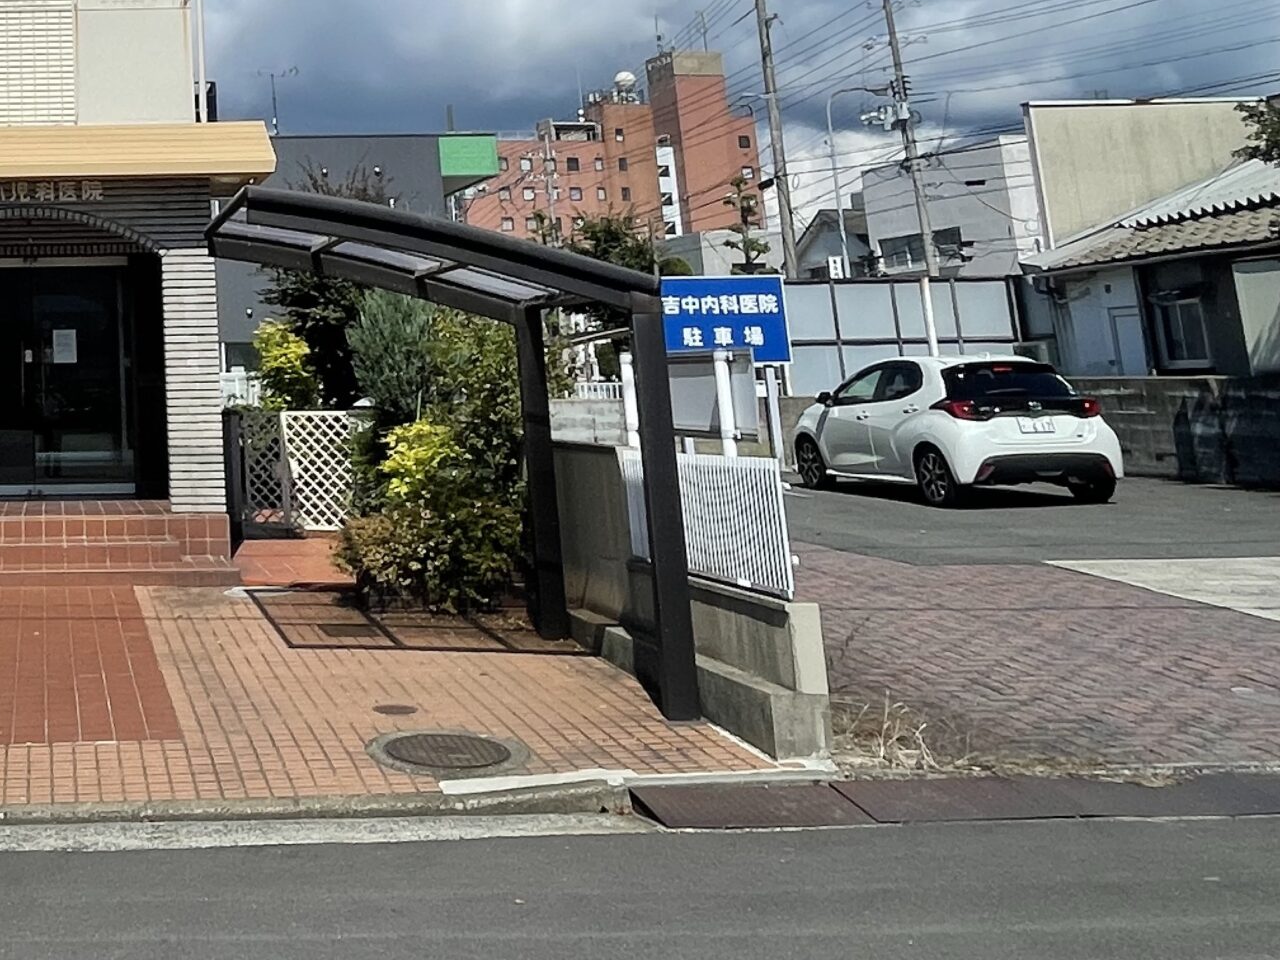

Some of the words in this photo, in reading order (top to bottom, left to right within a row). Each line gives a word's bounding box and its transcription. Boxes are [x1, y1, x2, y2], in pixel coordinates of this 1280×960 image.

[661, 294, 779, 315] 吉中内科医院
[682, 326, 765, 347] 駐車場
